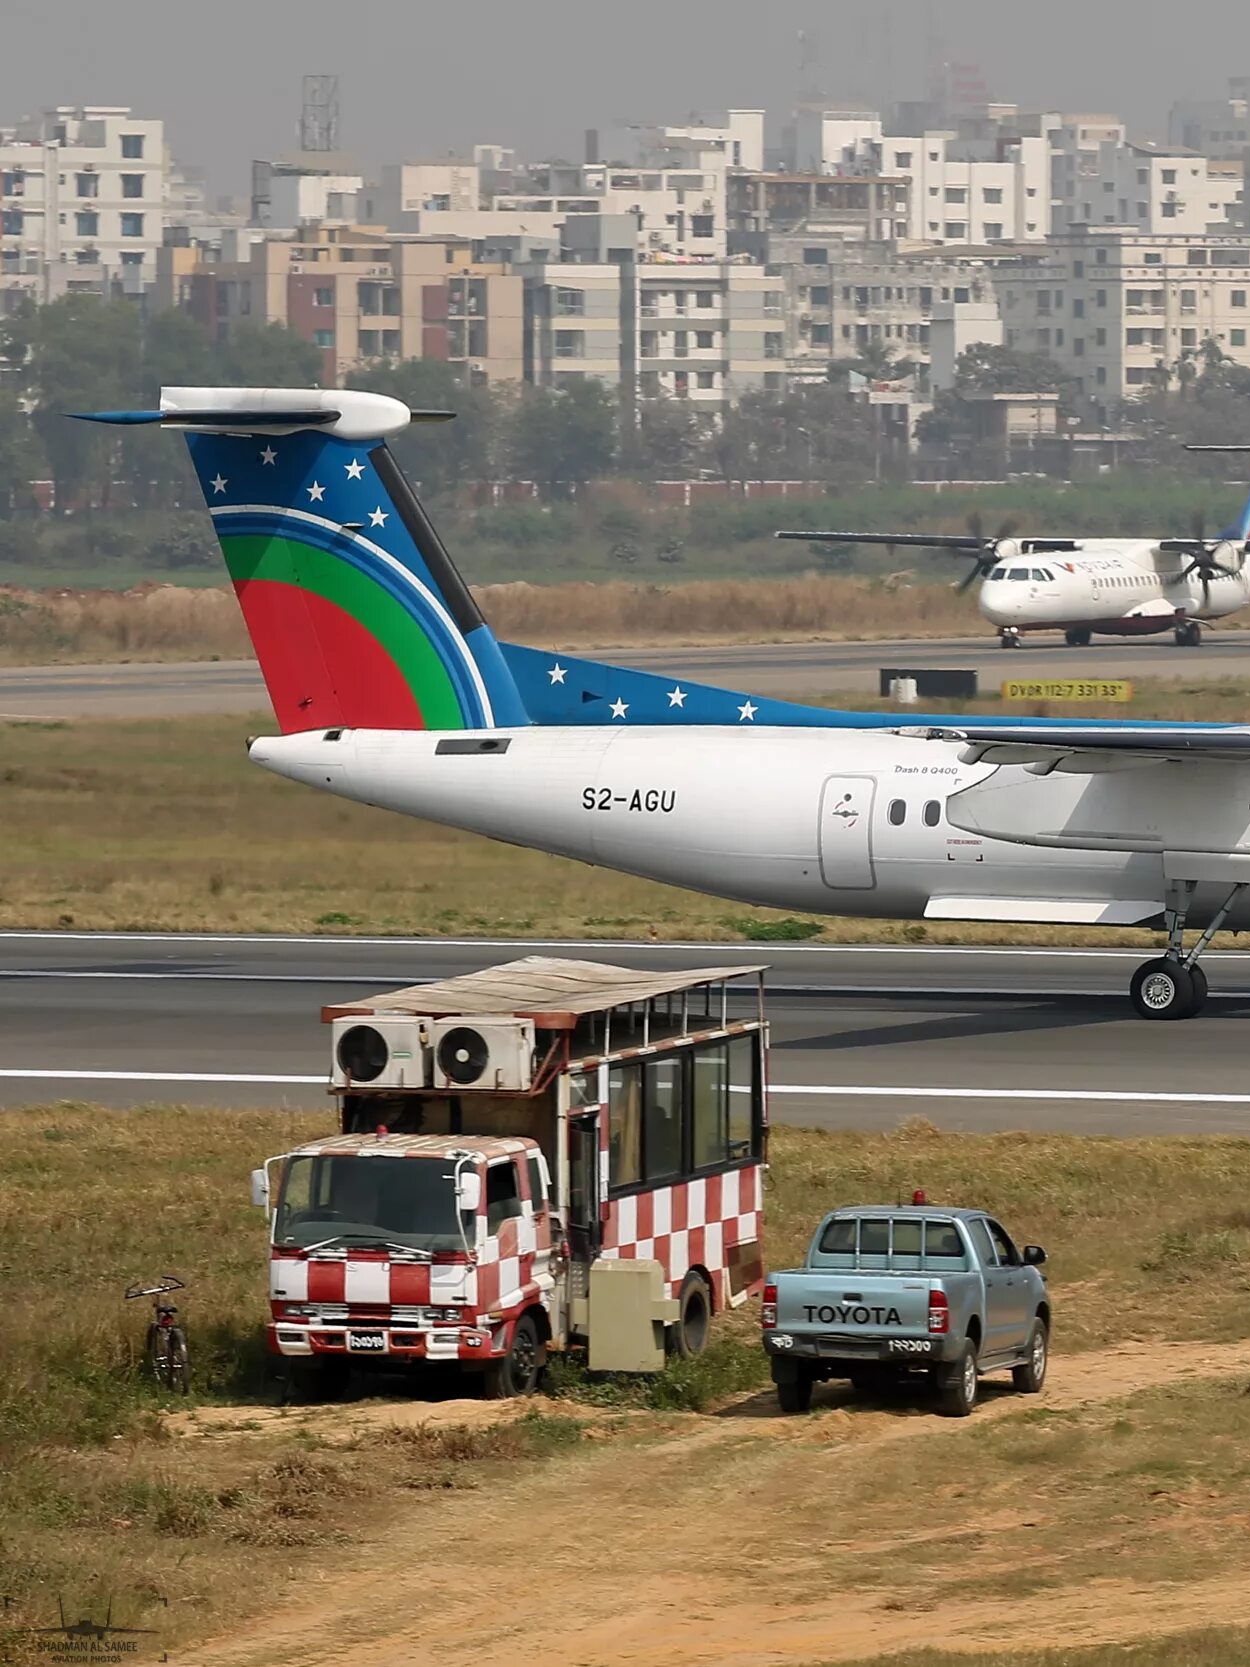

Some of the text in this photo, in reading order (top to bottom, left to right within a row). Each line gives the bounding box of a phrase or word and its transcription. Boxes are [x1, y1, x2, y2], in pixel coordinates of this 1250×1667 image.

[894, 764, 958, 775] Dash 8 Q400
[582, 787, 676, 813] S2-AGU
[803, 1305, 902, 1325] TOYOTA
